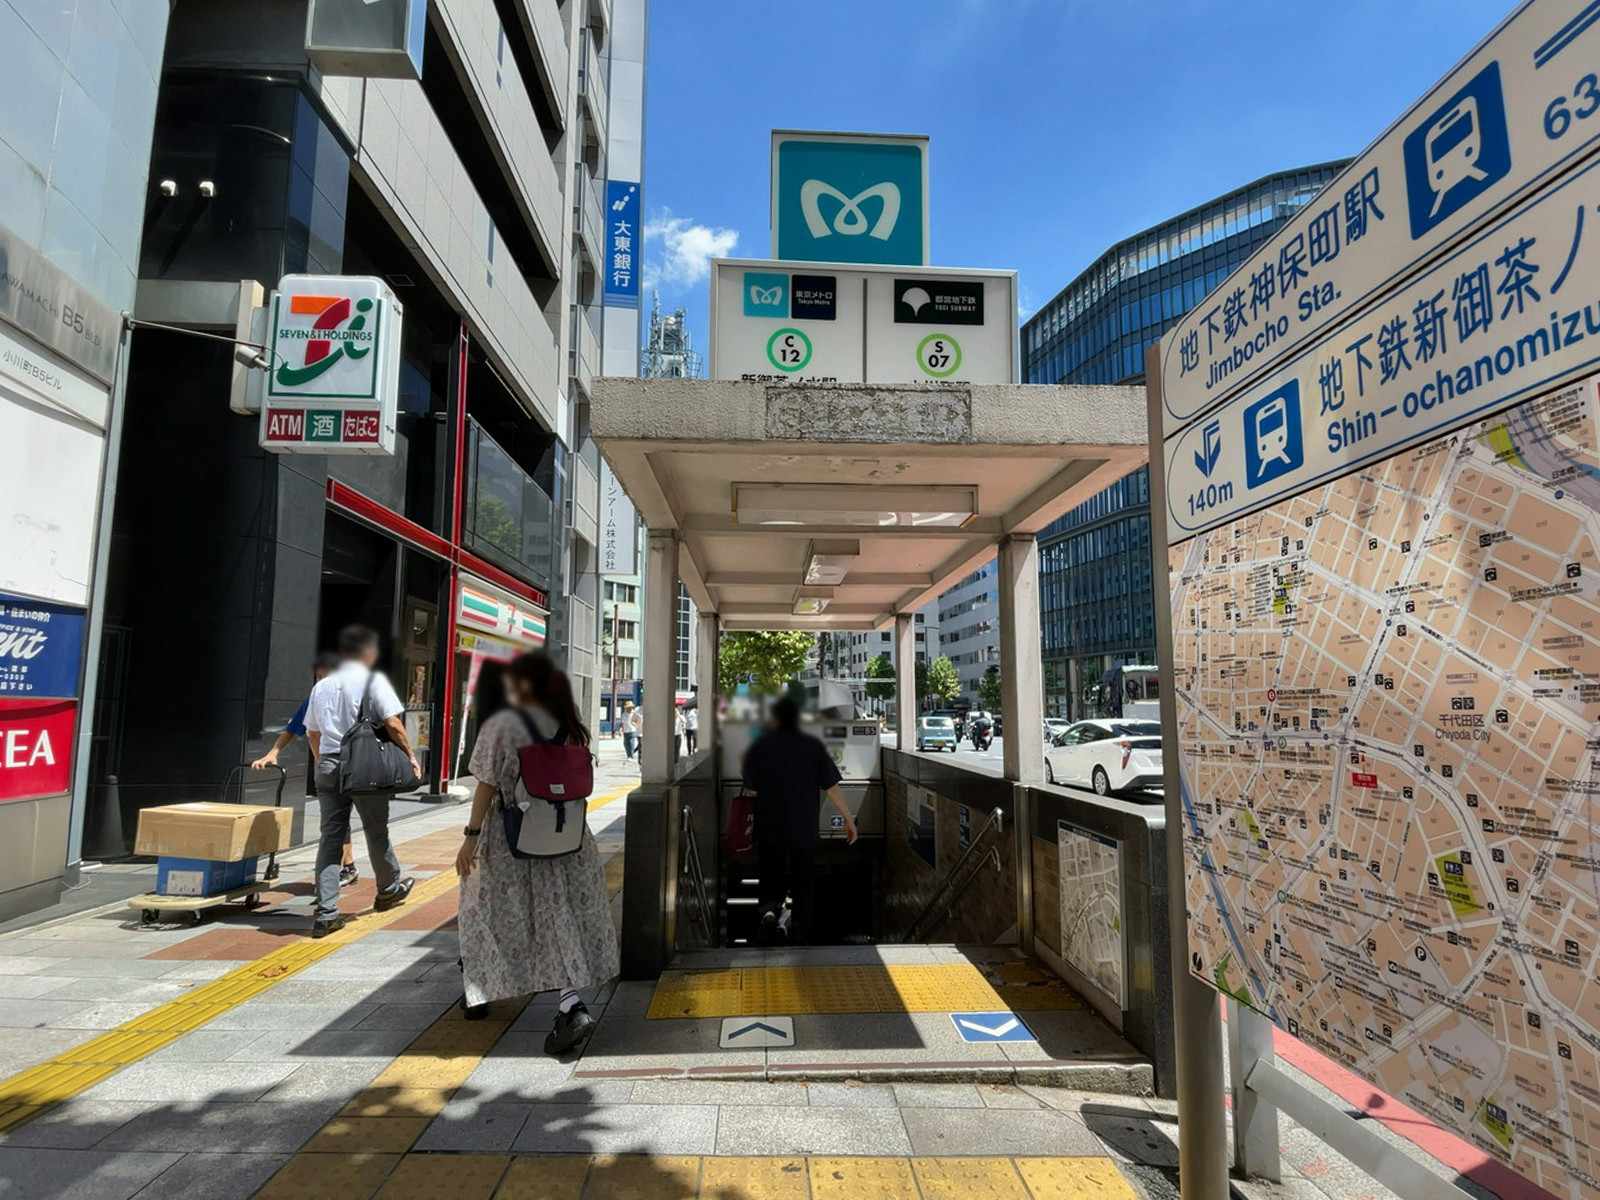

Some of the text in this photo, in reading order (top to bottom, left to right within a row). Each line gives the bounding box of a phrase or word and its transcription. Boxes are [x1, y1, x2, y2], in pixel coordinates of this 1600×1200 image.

[613, 220, 632, 288] 大東銀行
[1179, 166, 1385, 378] 地下鉄神保町駅
[795, 290, 833, 300] 東京メトロ
[62, 304, 84, 335] B5
[1318, 205, 1600, 417] 地下鉄新御茶ノ
[323, 330, 373, 342] HOLDINGS
[784, 335, 795, 348] C
[1205, 280, 1343, 390] Jimbocho Sta.
[780, 349, 801, 363] 12
[934, 340, 944, 354] S
[2, 349, 63, 391] 小川町B5ビル
[927, 354, 951, 369] 07
[269, 414, 301, 436] ATM
[312, 414, 335, 438] 酒
[345, 415, 378, 437] たばこ
[1185, 479, 1235, 518] 140m
[605, 470, 617, 570] ーンアーム株式会社
[1439, 713, 1485, 728] 千代田区
[1435, 728, 1492, 744] Chiyoda City
[0, 729, 56, 768] EA
